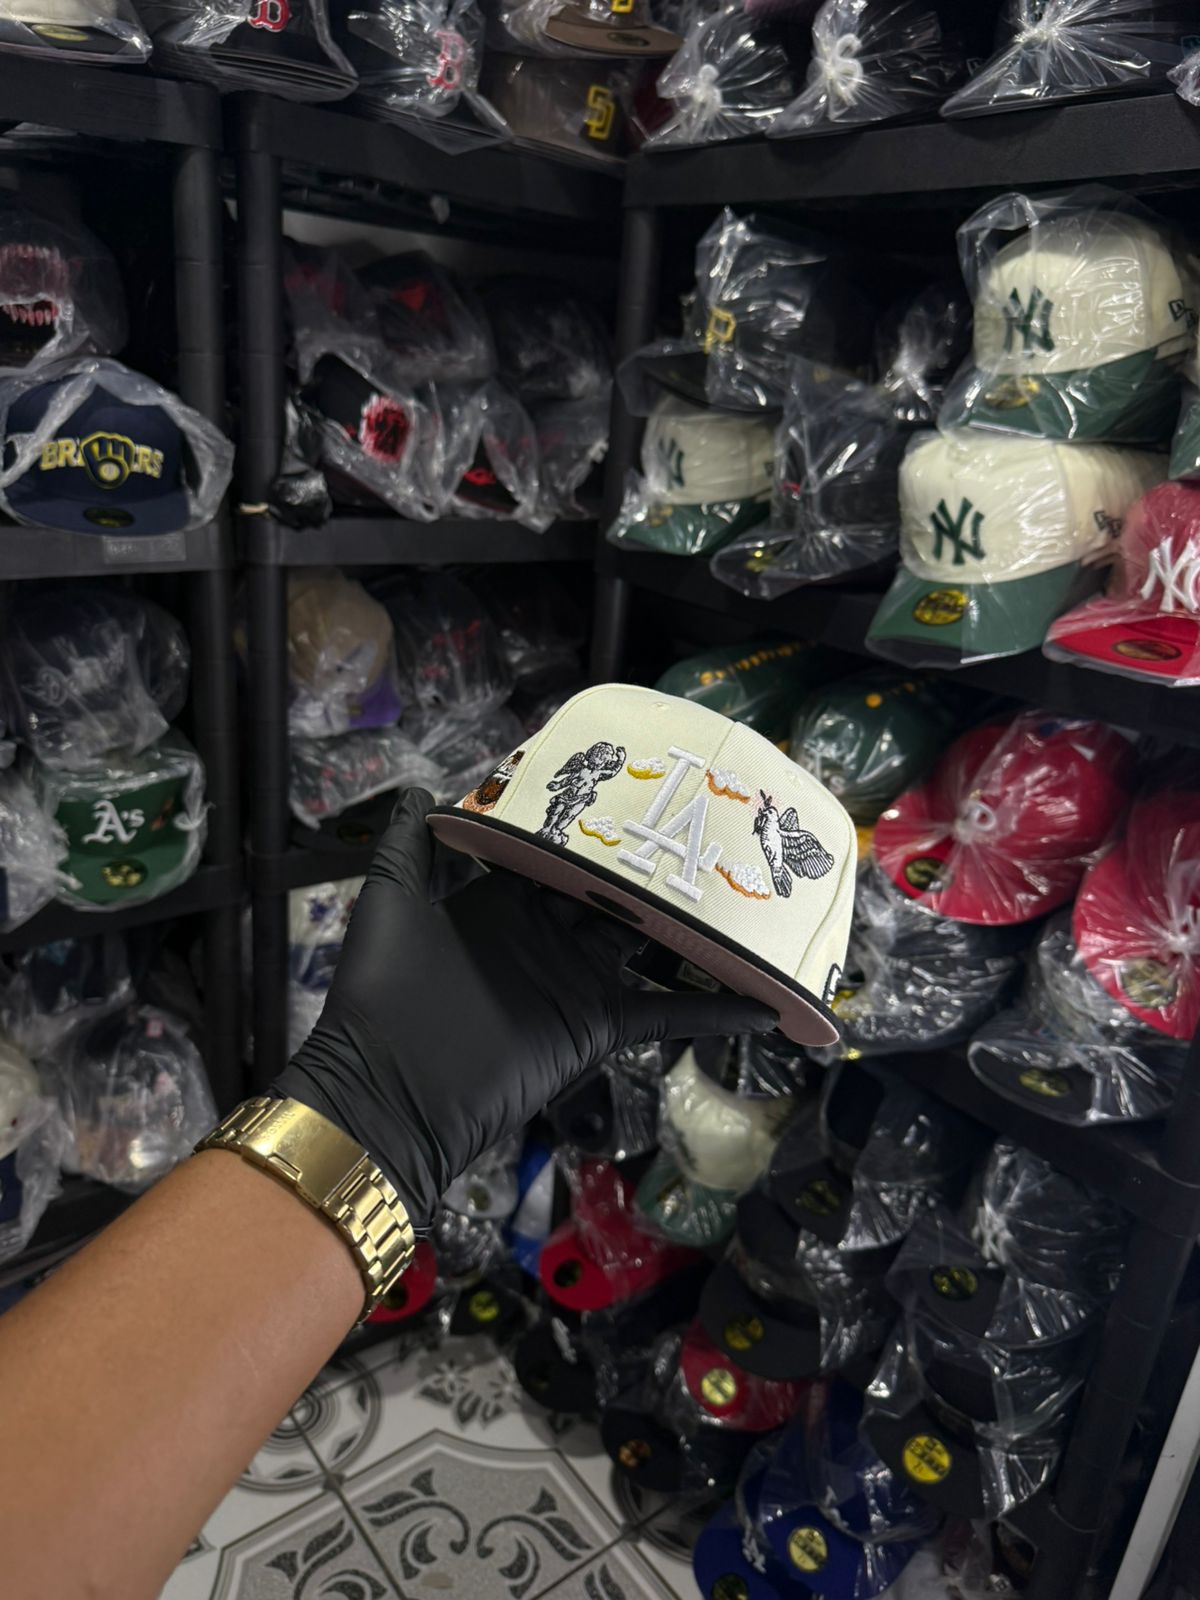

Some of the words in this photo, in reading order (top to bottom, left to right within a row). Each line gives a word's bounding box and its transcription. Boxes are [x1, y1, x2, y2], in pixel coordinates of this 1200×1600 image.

[425, 29, 467, 92] B
[1002, 285, 1055, 353] NY
[930, 496, 986, 566] NY
[1140, 535, 1200, 614] NY
[82, 799, 145, 844] A's
[617, 744, 724, 904] LA
